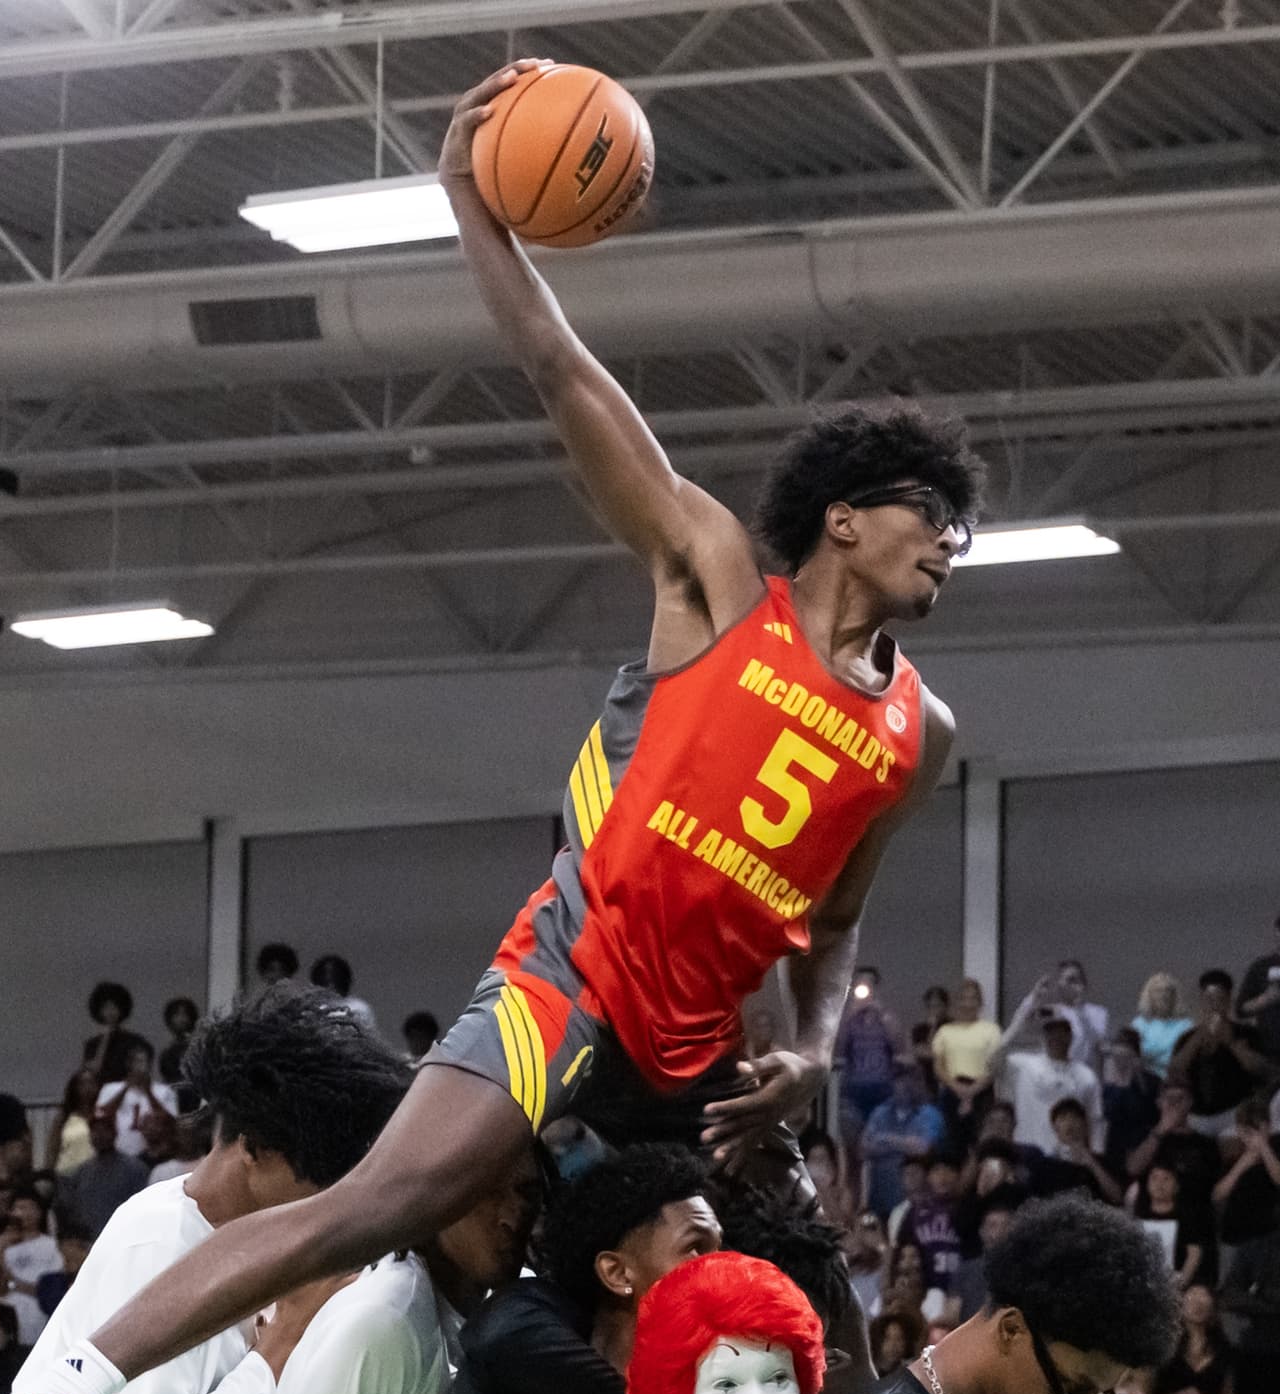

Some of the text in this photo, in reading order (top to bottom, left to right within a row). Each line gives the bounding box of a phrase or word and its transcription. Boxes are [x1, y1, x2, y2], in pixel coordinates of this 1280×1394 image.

[737, 657, 896, 784] McDONALD'S
[739, 727, 840, 850] 5
[647, 799, 813, 920] ALL AMERICAN
